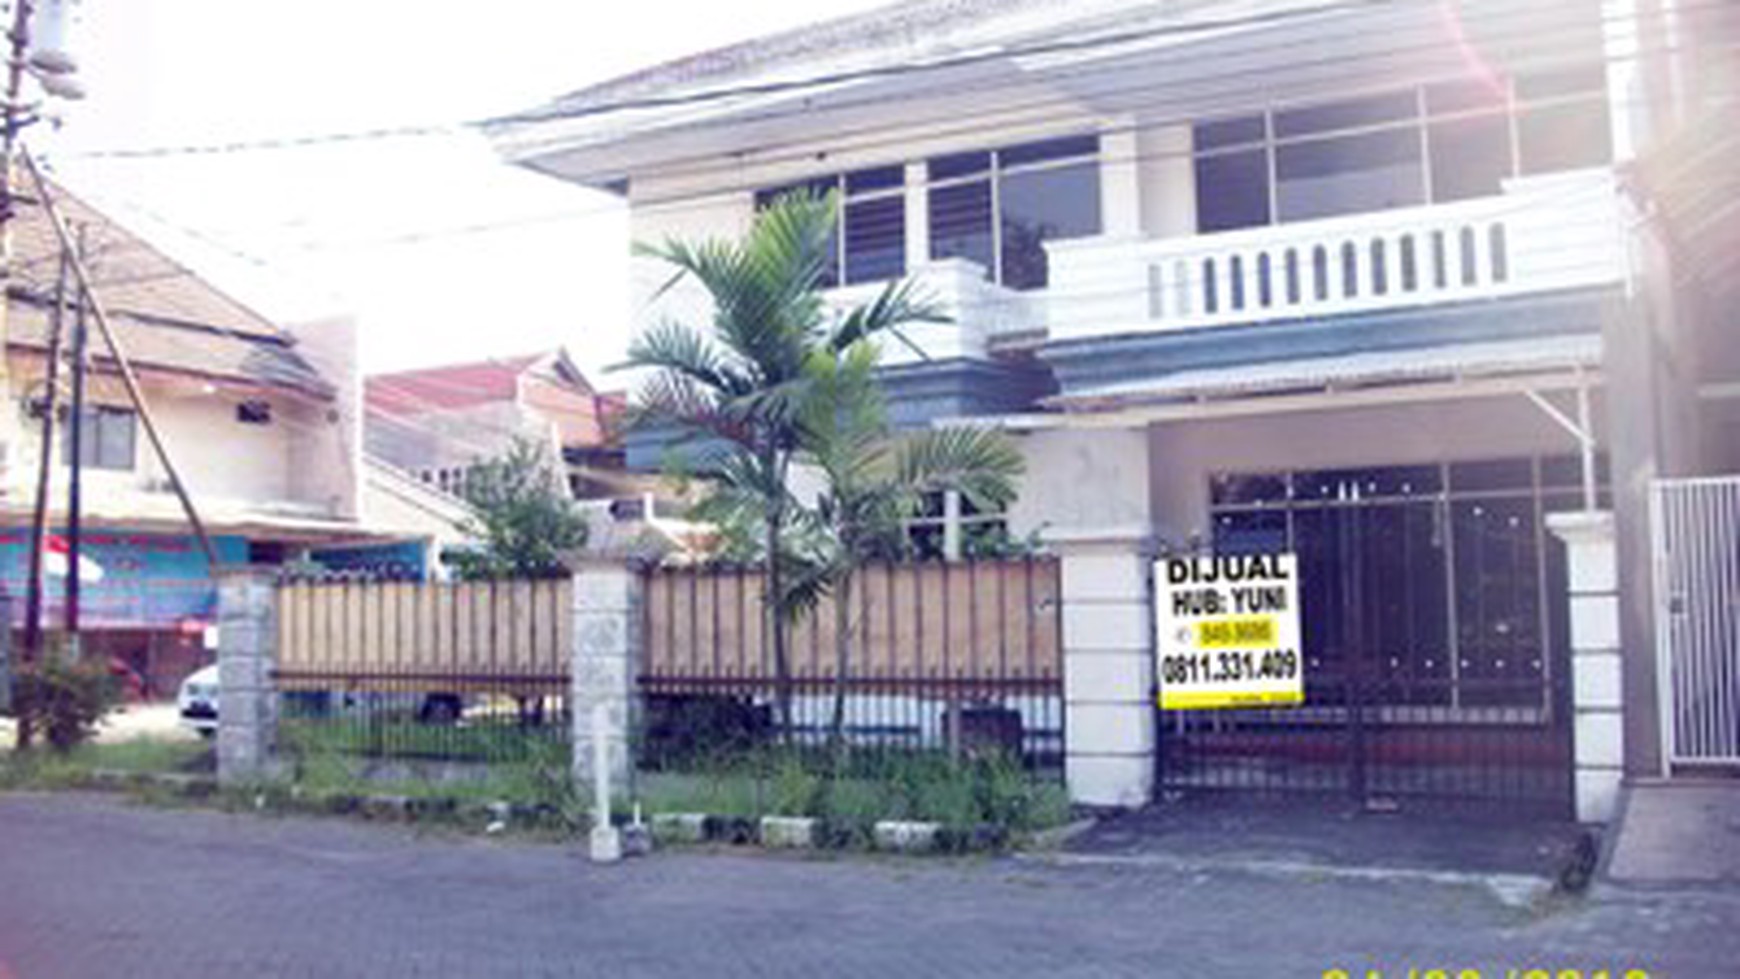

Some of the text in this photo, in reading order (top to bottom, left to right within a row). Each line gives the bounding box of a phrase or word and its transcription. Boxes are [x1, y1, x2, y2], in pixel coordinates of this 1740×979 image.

[1168, 555, 1288, 583] DIJUAL
[1172, 585, 1287, 616] HUB: YUNI
[1163, 648, 1297, 683] 0811.331.409
